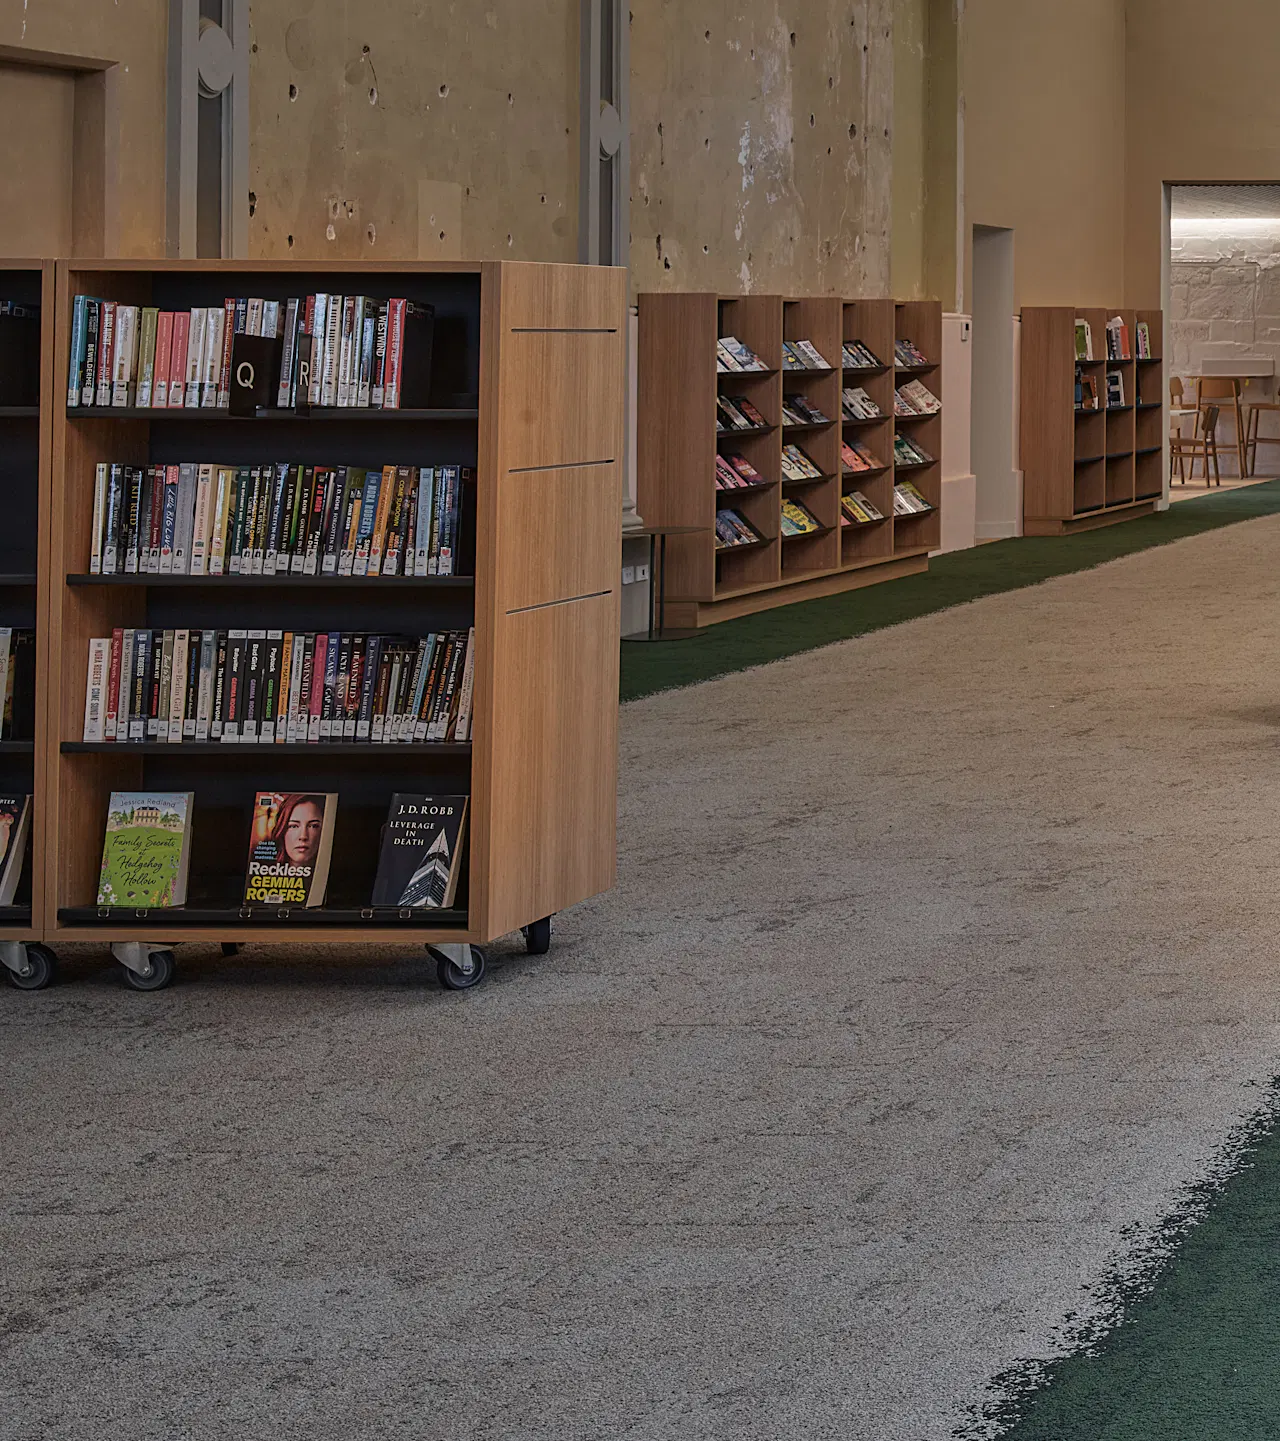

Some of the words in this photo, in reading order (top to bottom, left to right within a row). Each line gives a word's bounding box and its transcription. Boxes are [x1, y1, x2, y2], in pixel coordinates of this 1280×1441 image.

[376, 315, 386, 356] WESTWIND
[86, 344, 95, 388] BEWILDERME
[237, 362, 254, 389] Q
[300, 362, 309, 386] R
[366, 485, 377, 502] NORA
[397, 480, 405, 496] COME
[130, 502, 138, 525] REED
[166, 511, 174, 526] BIG
[361, 505, 374, 534] ROBERTS
[393, 498, 403, 526] SUNDOWN
[282, 514, 290, 541] VENDETTA
[329, 513, 338, 544] FORGOTTEN
[95, 650, 103, 663] NORA
[269, 648, 277, 672] Payback
[340, 652, 348, 671] HOLY
[452, 649, 461, 672] Covenant
[93, 664, 102, 686] ROBERTS
[137, 657, 145, 677] ROBERTS
[326, 648, 335, 686] SYCAMORE
[428, 669, 436, 684] WHERE
[91, 688, 100, 701] COME
[175, 675, 183, 696] Berlin
[337, 672, 346, 699] ISLAND
[90, 703, 99, 715] SUND
[173, 698, 181, 712] Girl
[423, 694, 431, 712] MISSING
[147, 798, 175, 808] Redland
[421, 805, 453, 815] ROBB
[390, 821, 435, 829] LEVERAGE
[112, 835, 142, 851] Family
[146, 835, 176, 848] Secrets
[117, 855, 163, 874] Hedgehog
[249, 861, 311, 877] Reckless
[121, 871, 156, 886] Hollow
[251, 876, 303, 888] GEMMA
[246, 888, 306, 902] ROGERS
